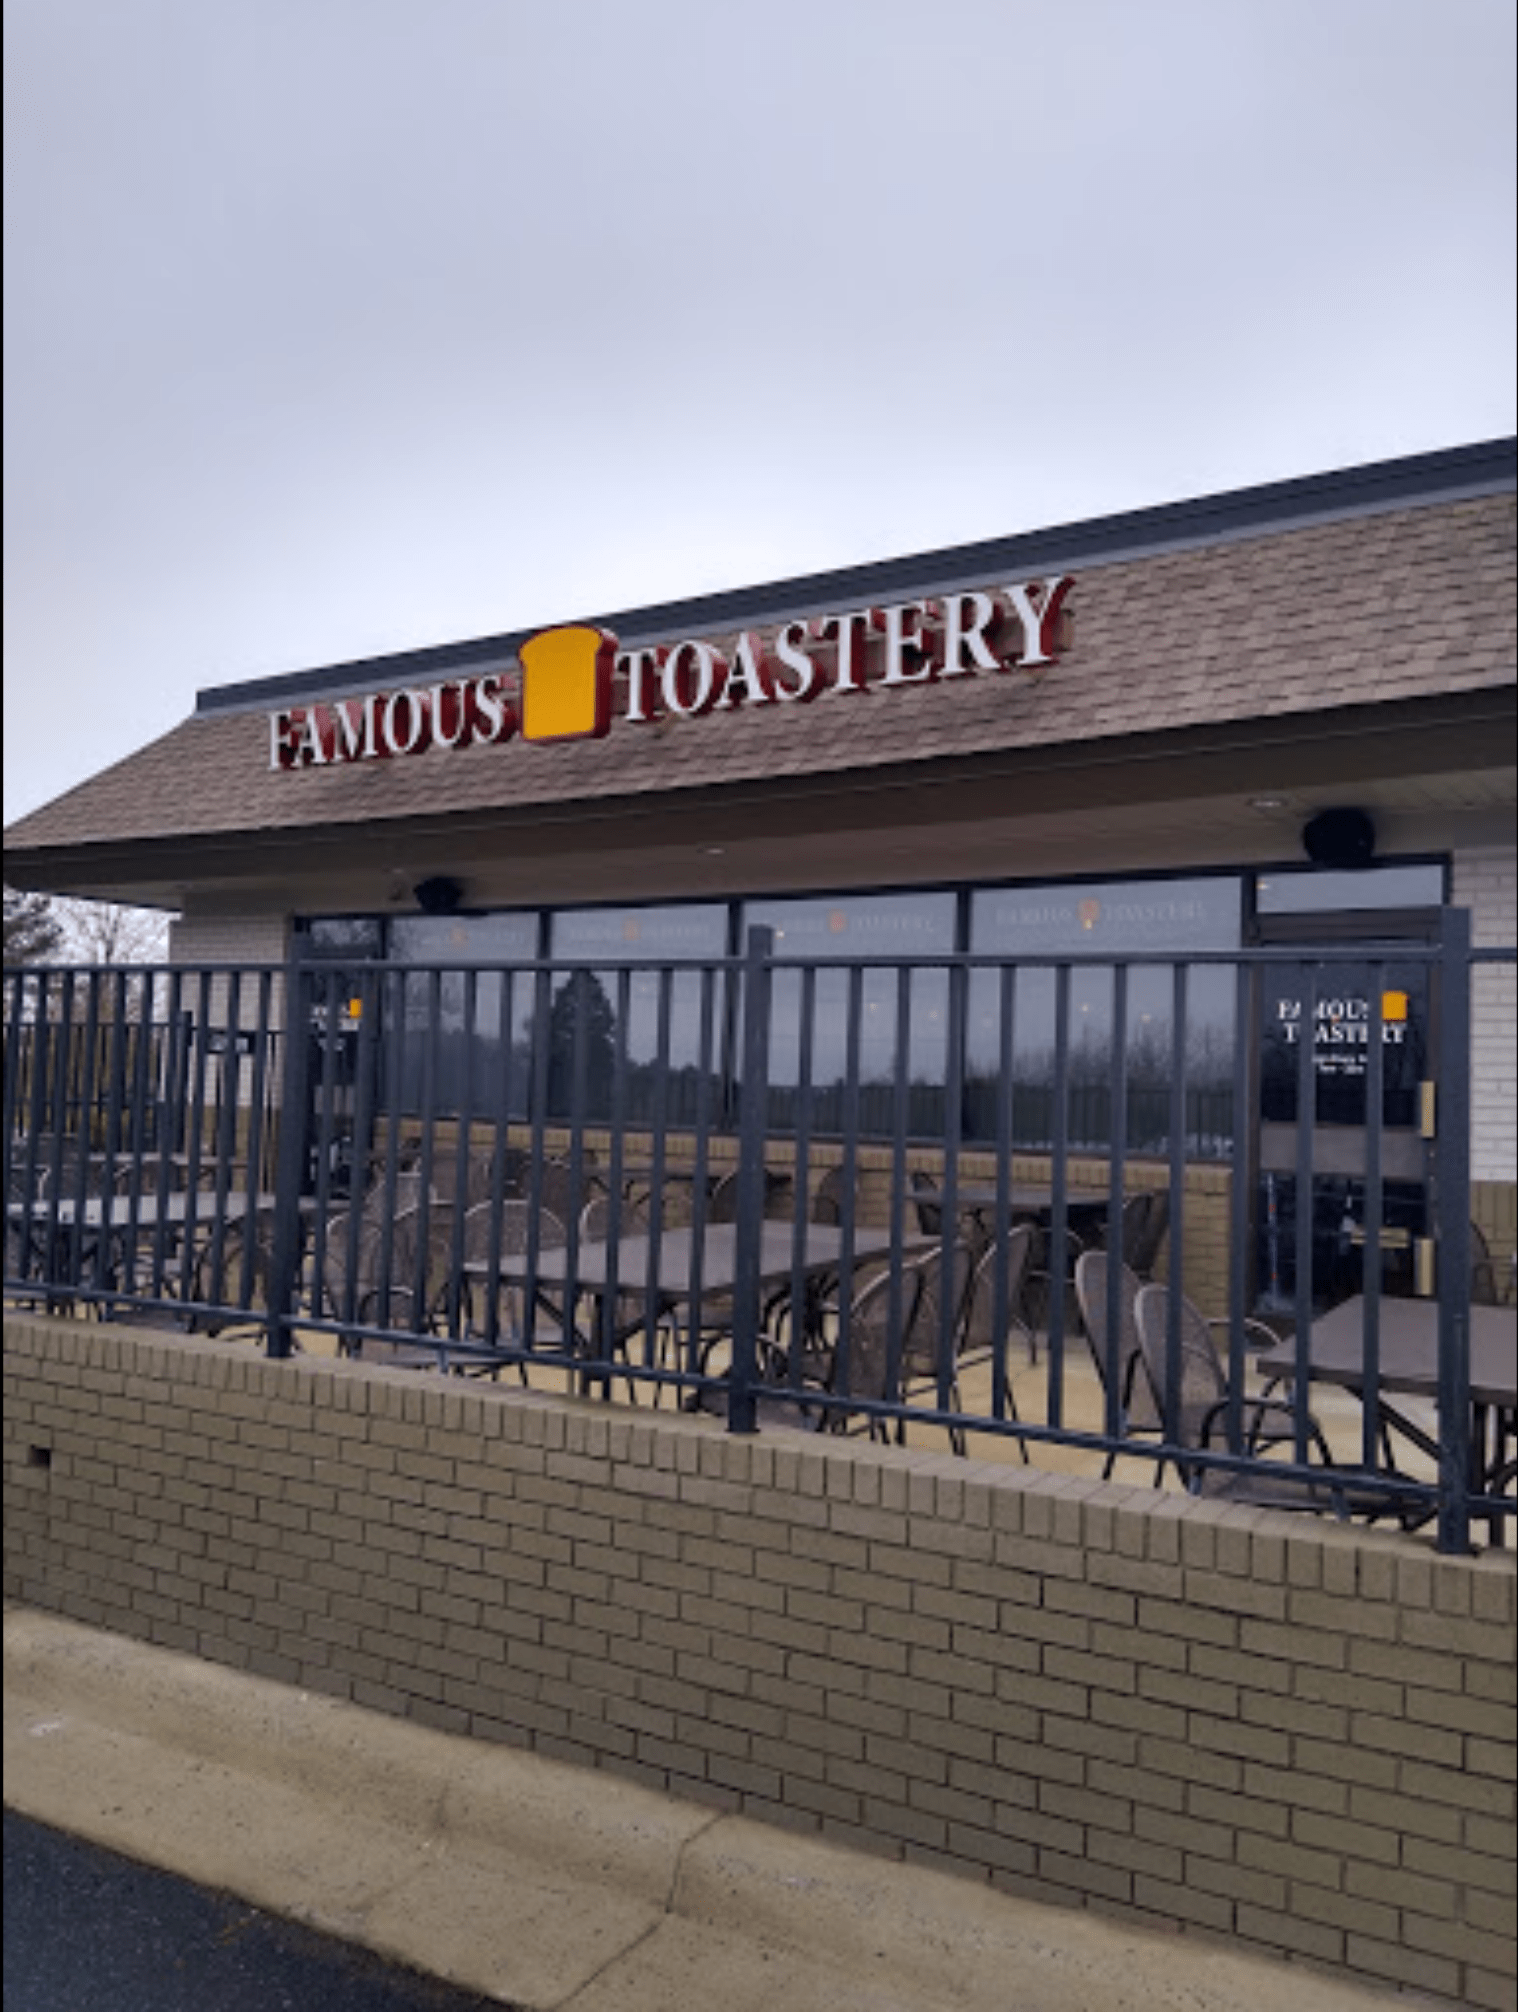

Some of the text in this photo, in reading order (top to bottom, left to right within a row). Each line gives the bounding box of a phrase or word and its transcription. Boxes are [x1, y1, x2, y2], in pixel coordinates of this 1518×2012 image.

[267, 576, 1072, 771] FAMOUS TOASTERY
[1282, 1022, 1407, 1043] TASTEY
